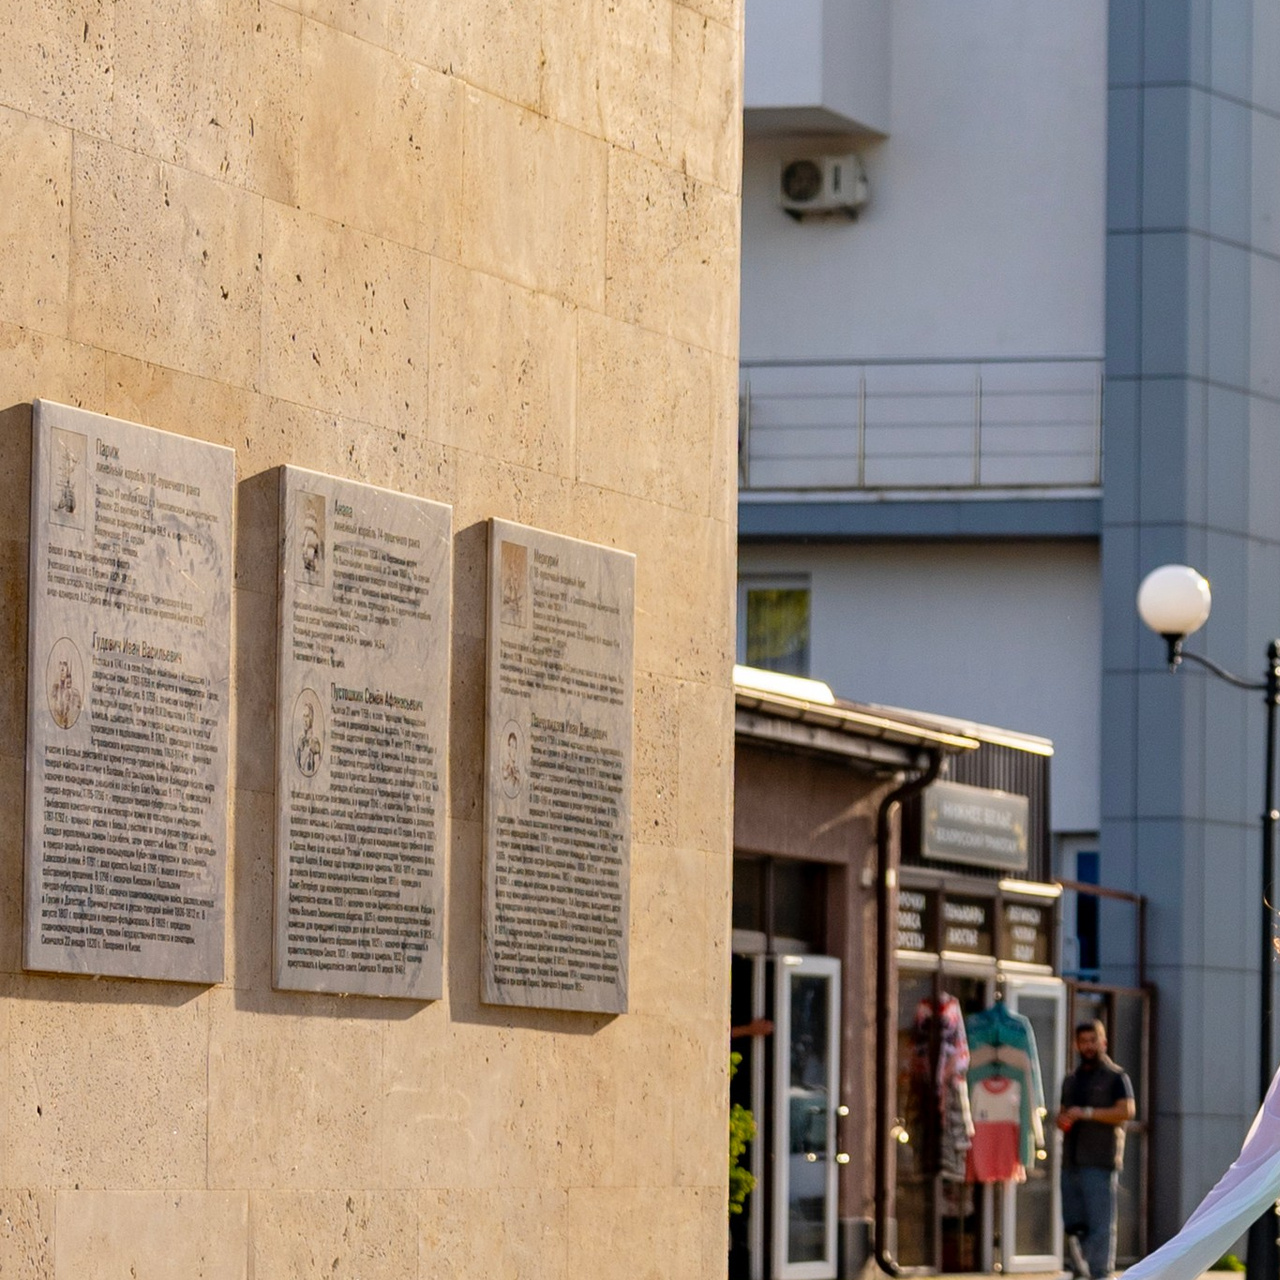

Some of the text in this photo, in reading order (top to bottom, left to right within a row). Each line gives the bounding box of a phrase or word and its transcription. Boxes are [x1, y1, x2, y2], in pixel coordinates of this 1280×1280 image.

[96, 438, 119, 460] Париж
[92, 632, 182, 661] Гудович Иван Васильевич
